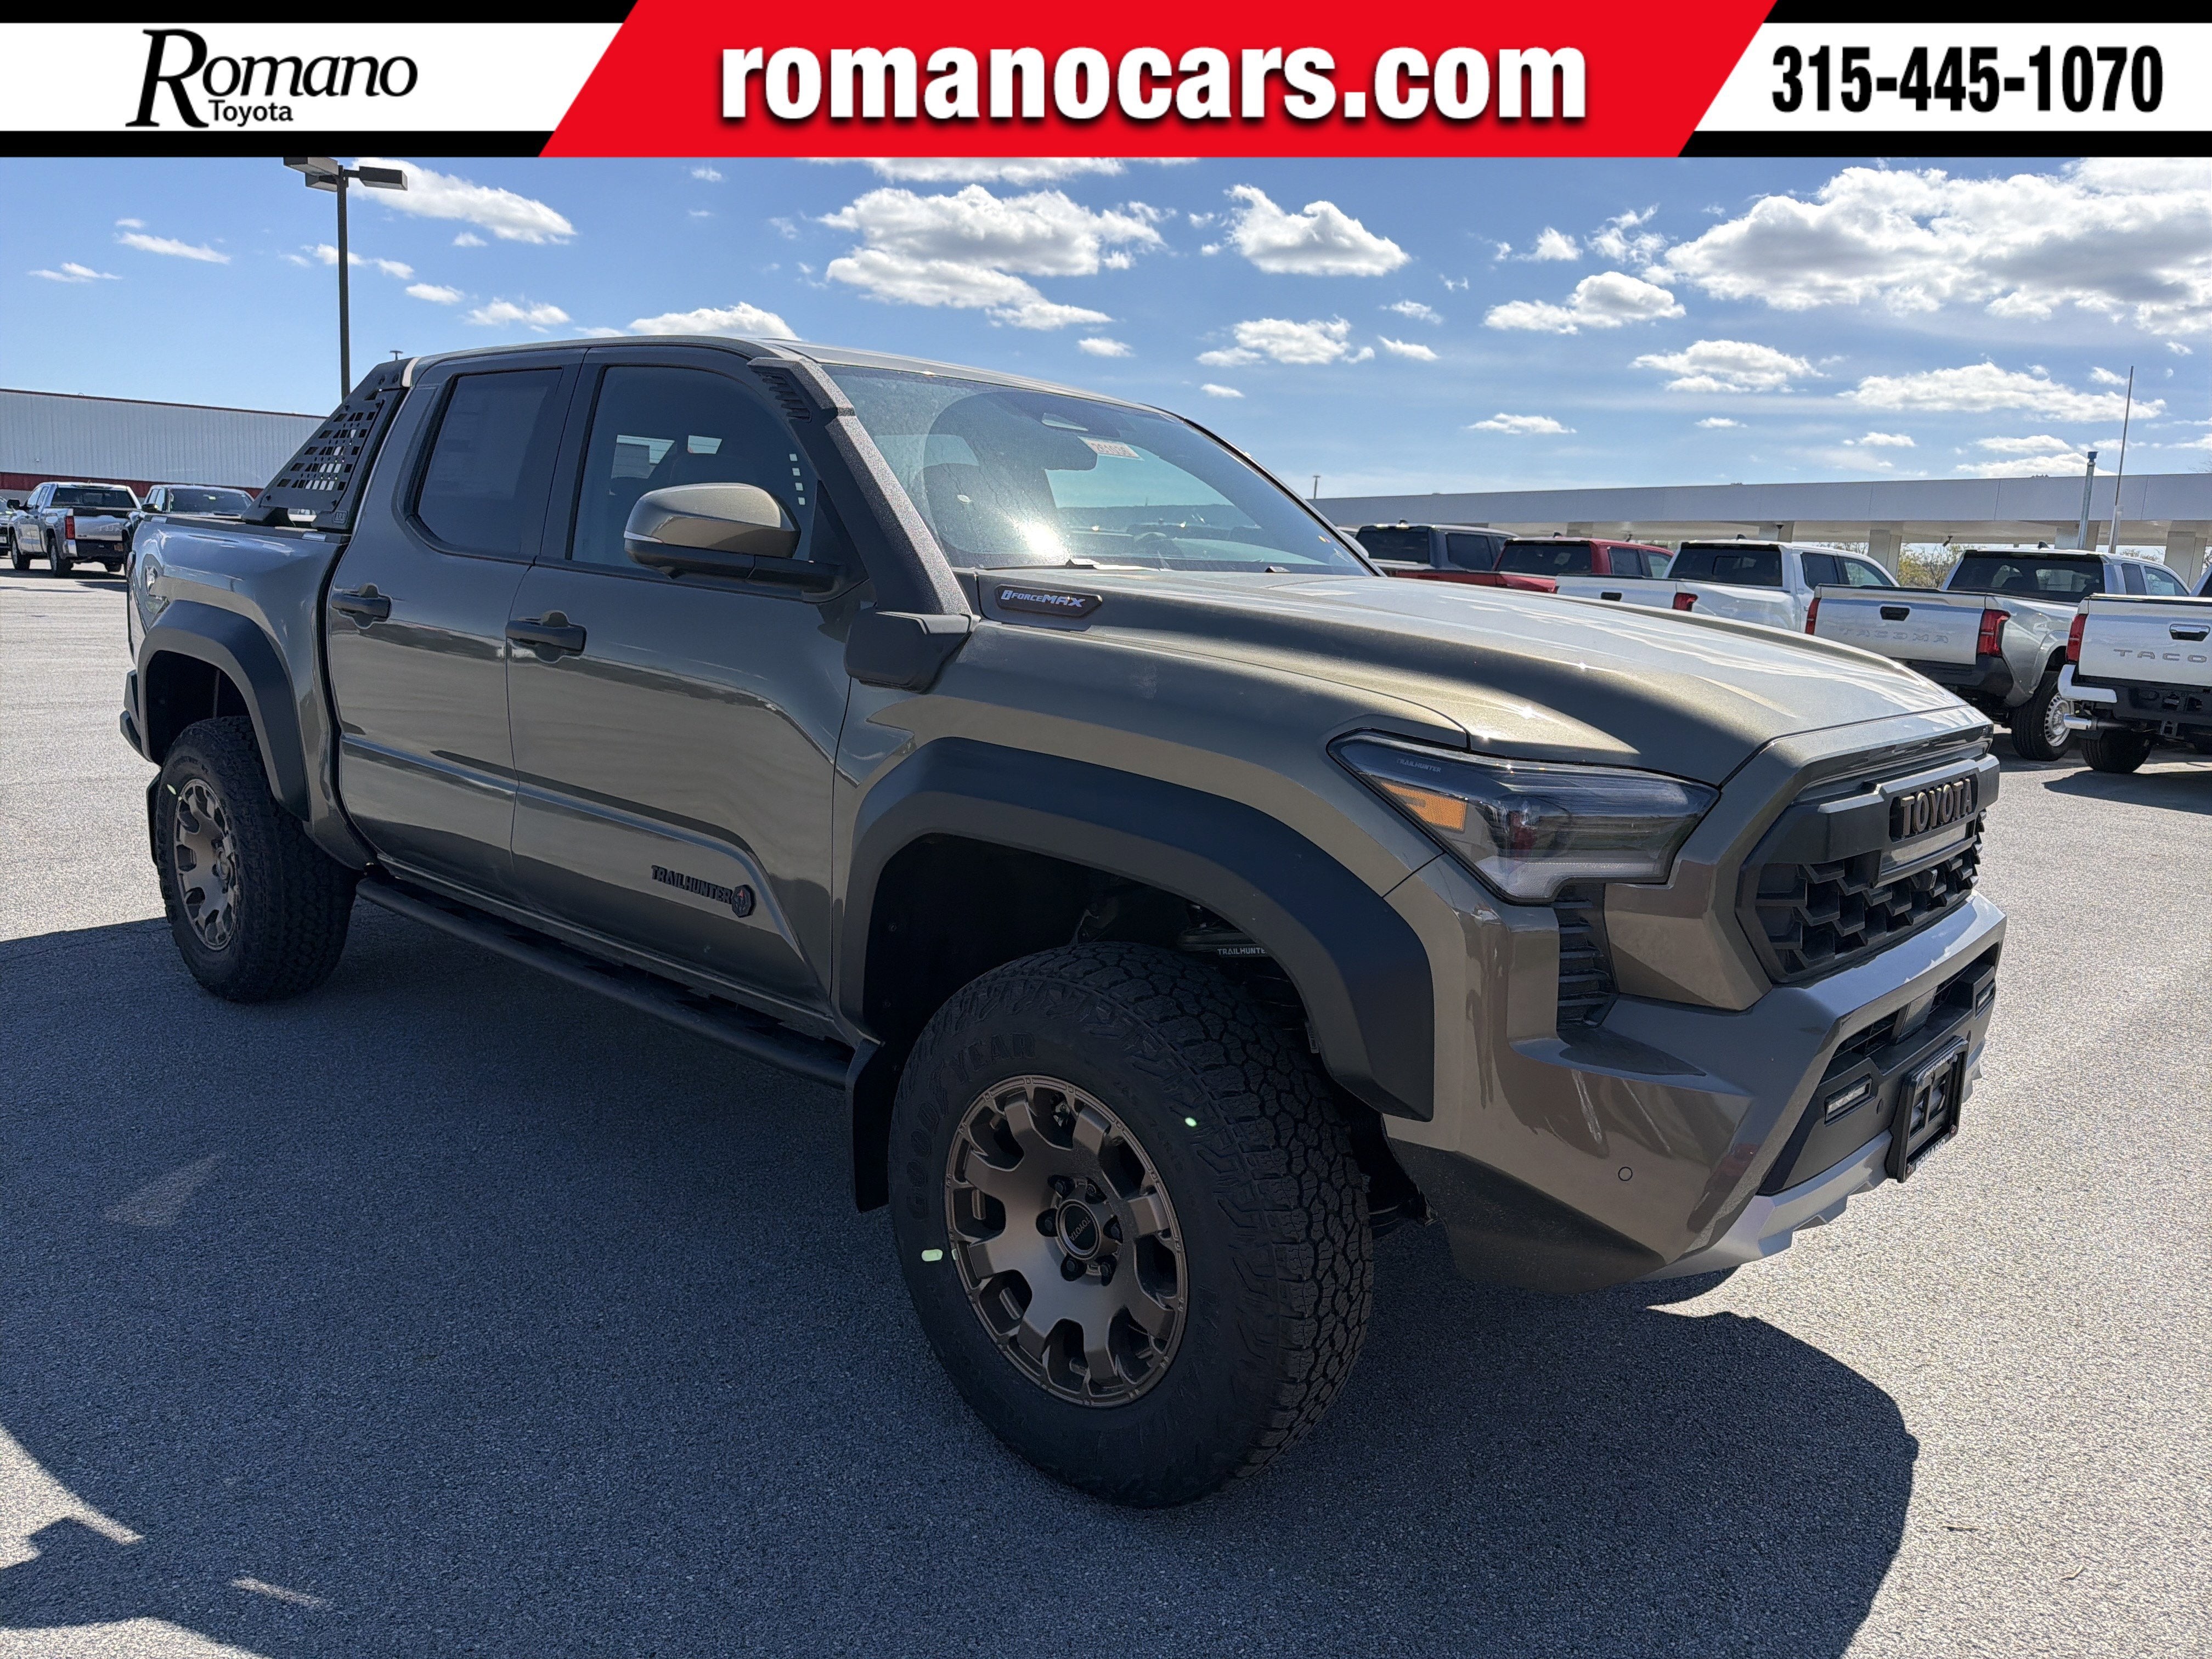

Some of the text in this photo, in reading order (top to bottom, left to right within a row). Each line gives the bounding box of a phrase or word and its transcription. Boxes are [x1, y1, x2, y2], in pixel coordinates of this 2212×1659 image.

[1397, 758, 1442, 773] TRAILHUNTER
[1900, 778, 1973, 837] TOYOTA
[651, 865, 733, 904] TRAILHUNTER
[1069, 1215, 1091, 1242] TOYOTA
